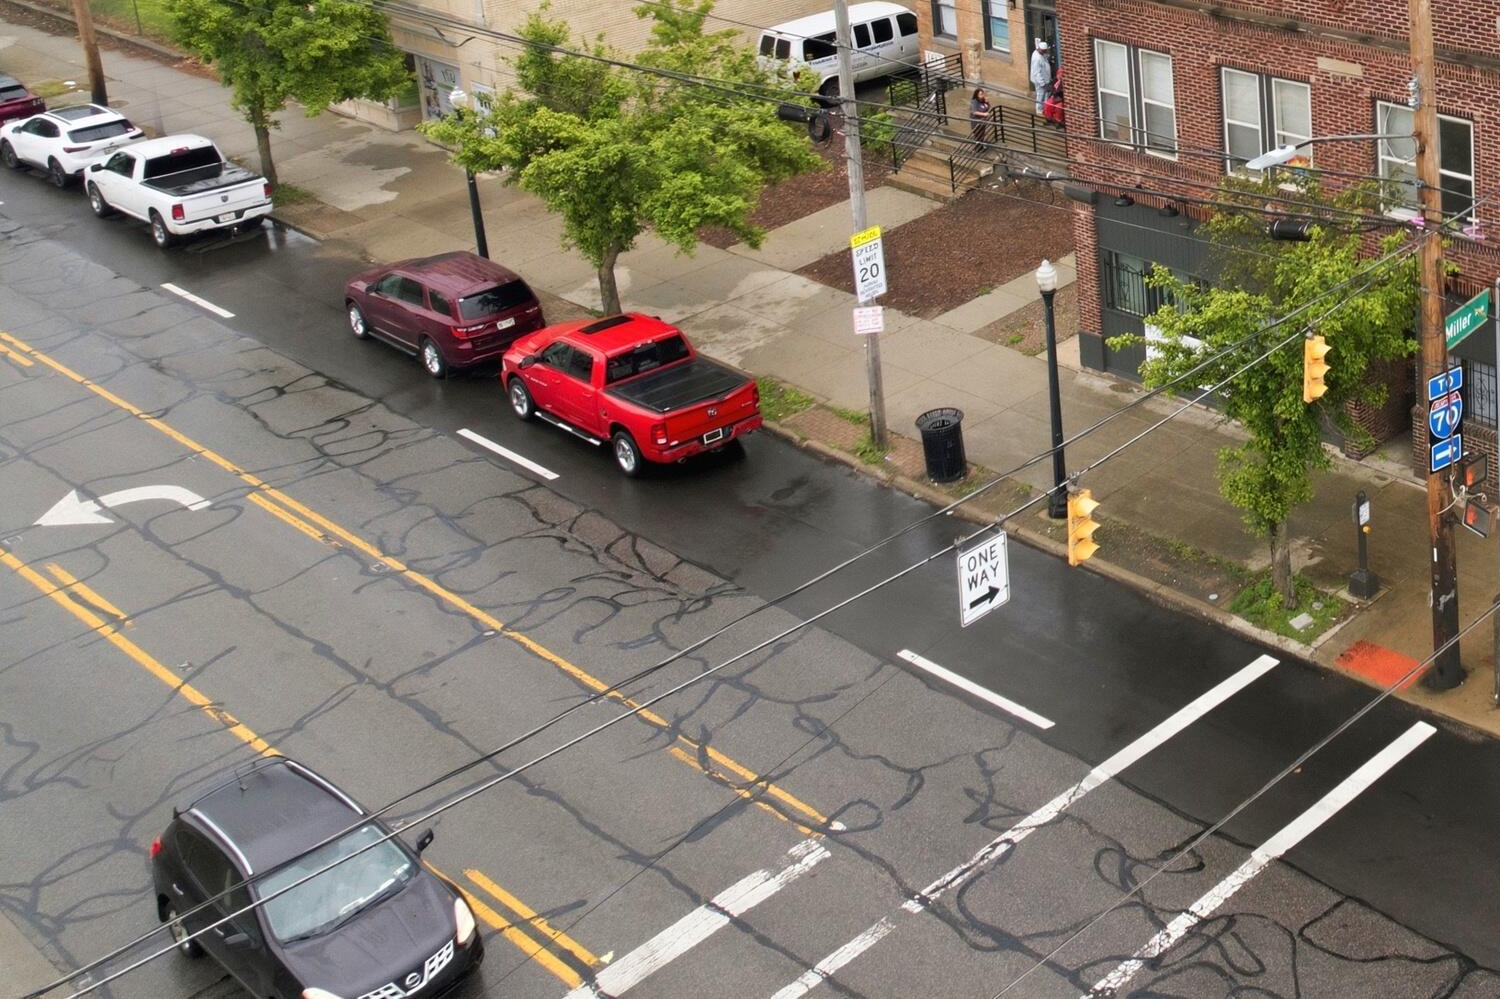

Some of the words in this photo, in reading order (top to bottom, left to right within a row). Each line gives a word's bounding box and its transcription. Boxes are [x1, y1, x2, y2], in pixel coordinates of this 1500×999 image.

[855, 242, 879, 257] SPEED
[859, 252, 877, 266] LIMIT
[859, 263, 880, 283] 20
[1445, 312, 1472, 343] Miller
[1438, 375, 1454, 392] TO
[1433, 405, 1459, 432] 70
[967, 543, 999, 573] ONE
[967, 560, 1000, 592] WAY
